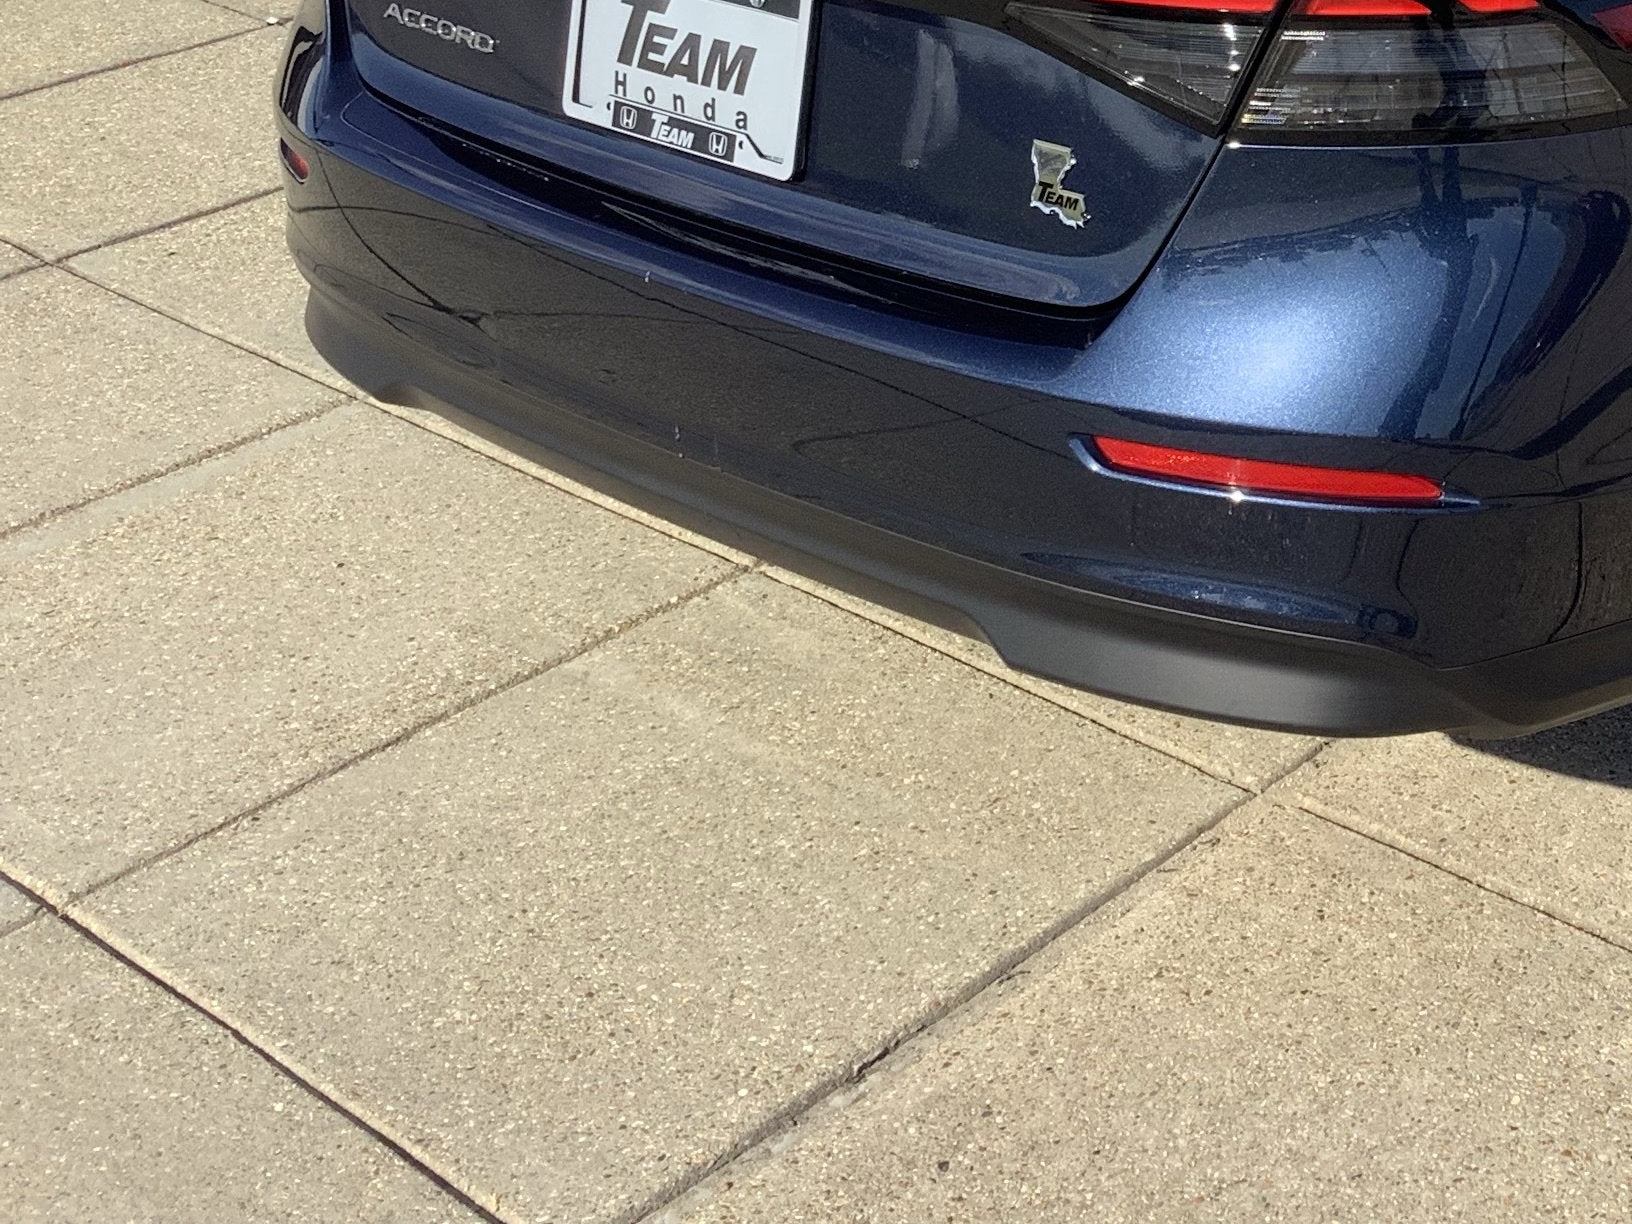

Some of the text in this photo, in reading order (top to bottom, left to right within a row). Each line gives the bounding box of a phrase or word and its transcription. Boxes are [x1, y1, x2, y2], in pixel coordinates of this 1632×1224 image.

[383, 3, 494, 52] ACCORD
[614, 70, 749, 131] Honda
[650, 114, 695, 149] TEAM
[1038, 181, 1079, 211] TEAM
